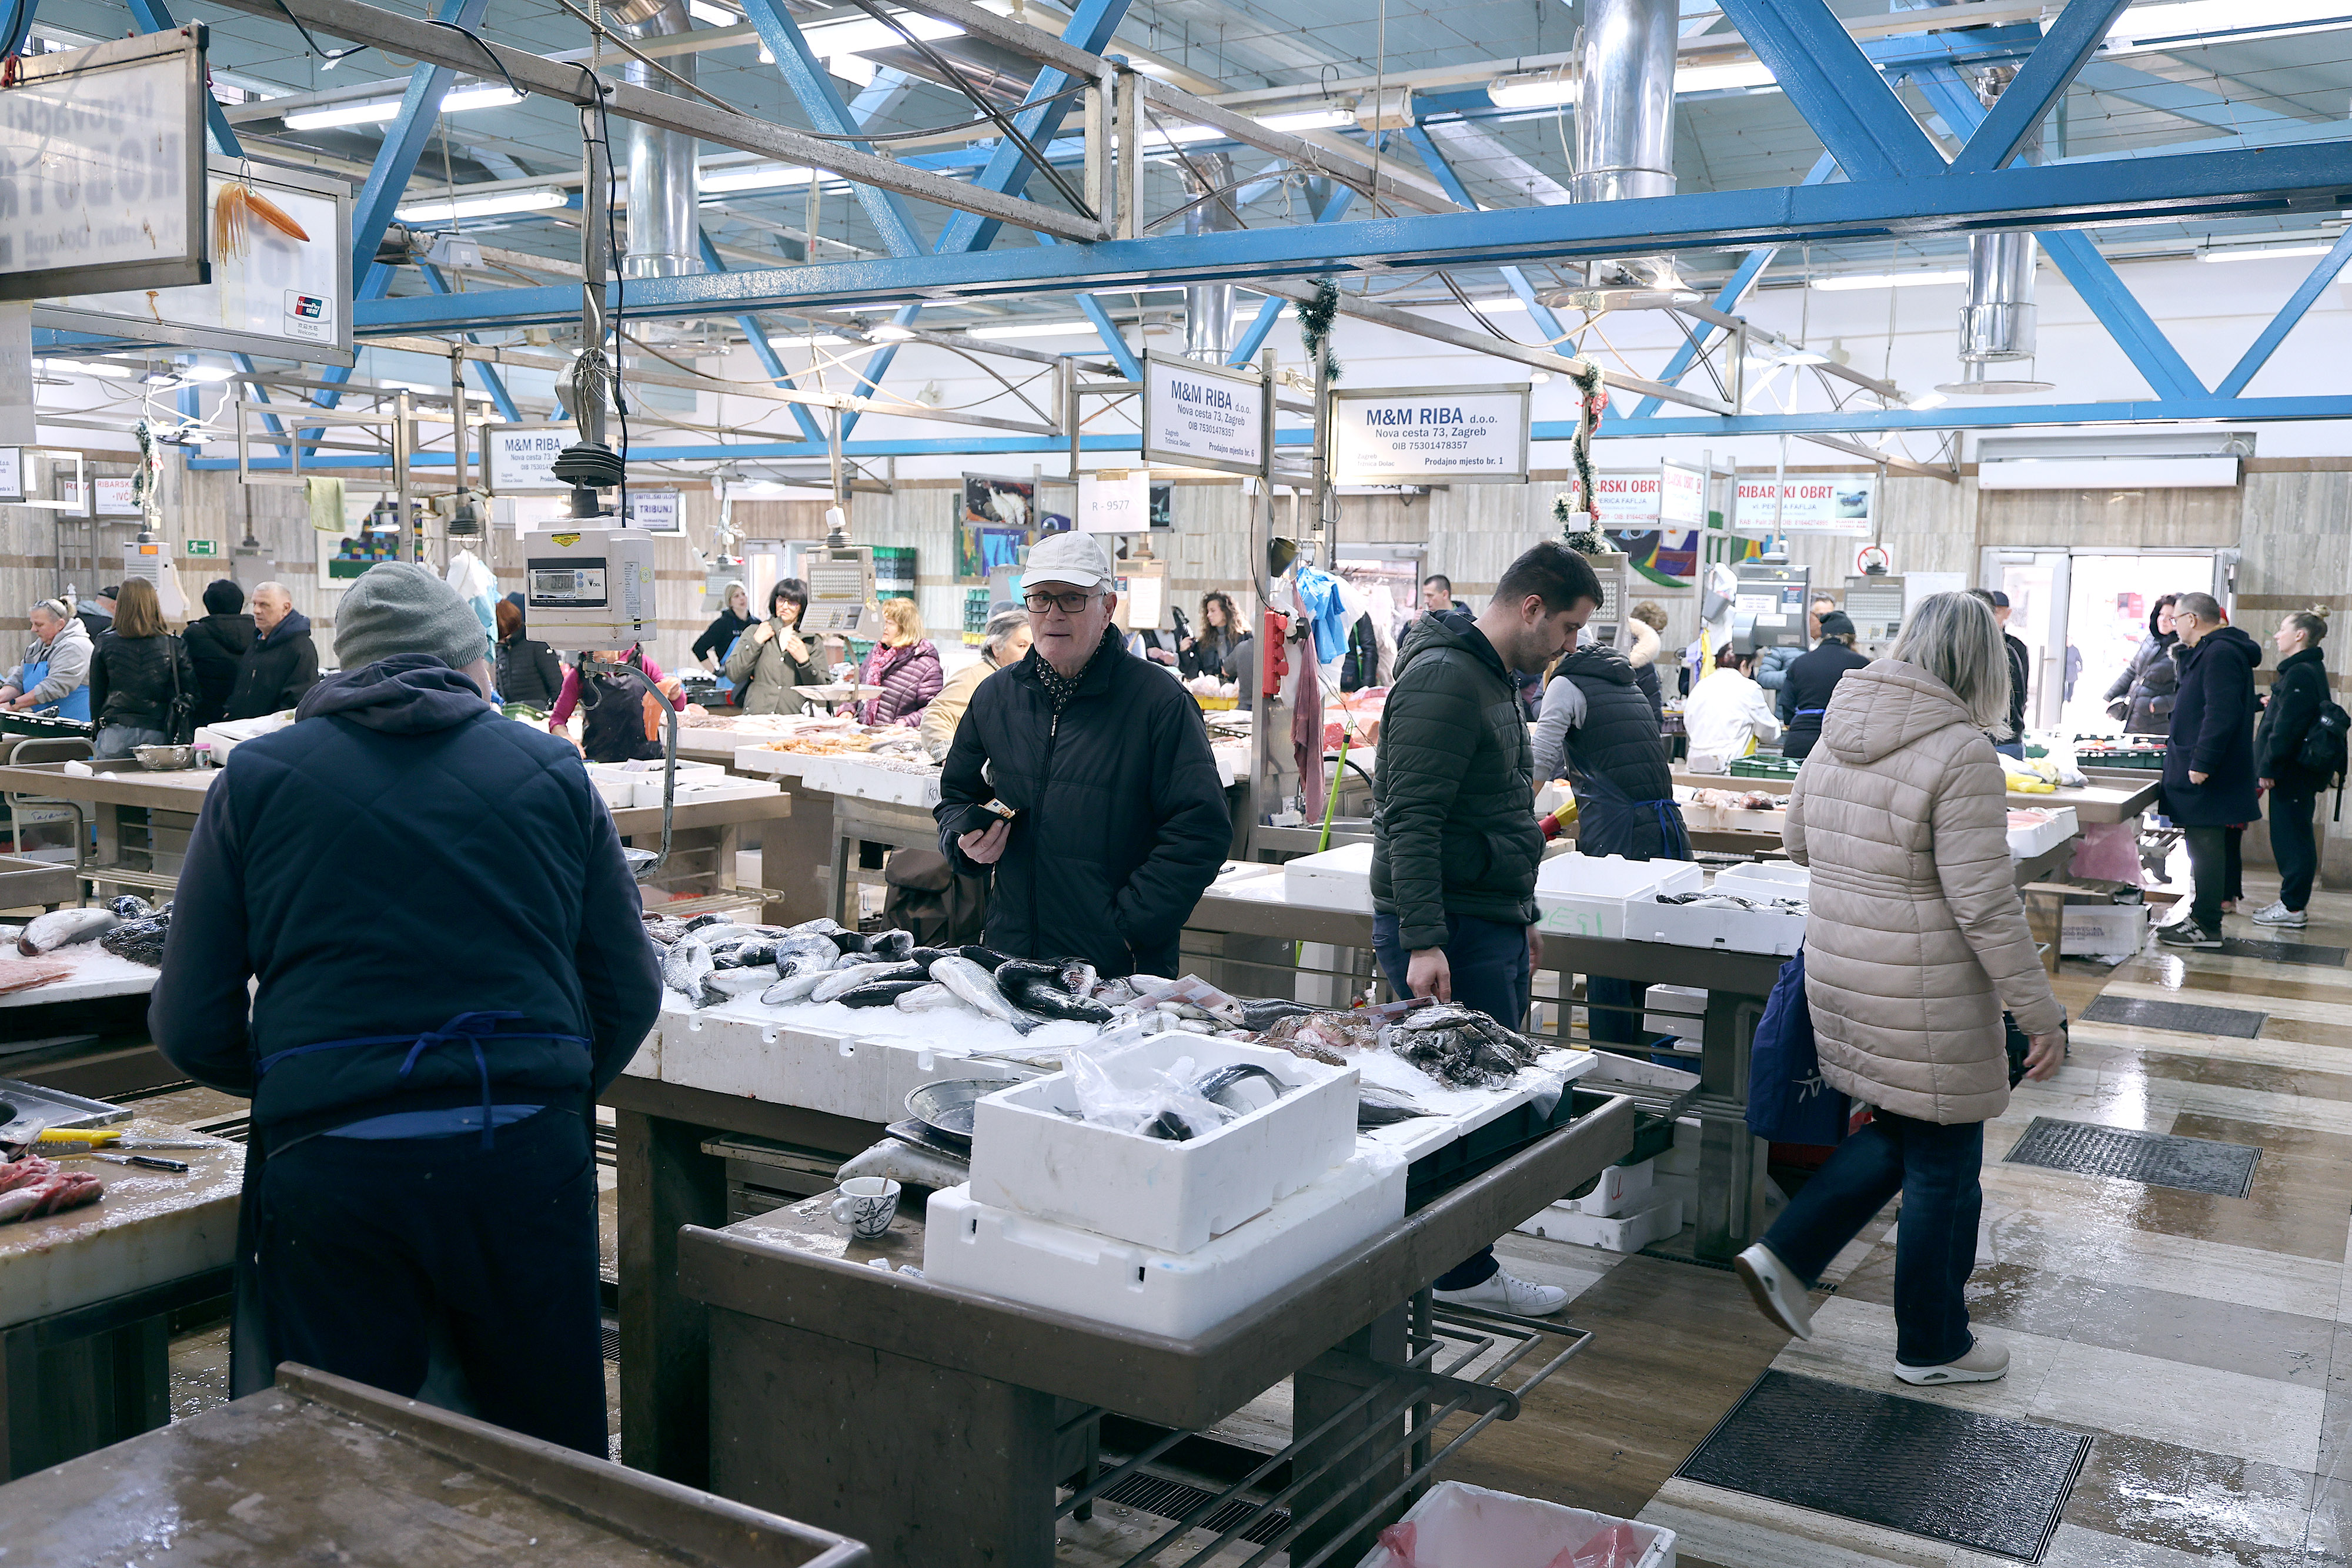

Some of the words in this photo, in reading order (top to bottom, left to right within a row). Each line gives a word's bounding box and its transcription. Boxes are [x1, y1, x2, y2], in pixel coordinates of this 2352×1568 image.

[298, 300, 320, 311] UnionPay
[1171, 380, 1201, 404] M&M
[1206, 387, 1232, 410] RIBA
[1235, 403, 1251, 414] d.o.o.
[1177, 403, 1193, 416] Nova
[1195, 409, 1211, 420] cesta
[1214, 411, 1223, 423] 73,
[1225, 413, 1245, 426] Zagreb
[1367, 408, 1412, 425] M&M
[1420, 407, 1463, 424] RIBA
[1470, 414, 1498, 423] d.o.o.
[1165, 429, 1179, 437] Zagreb
[1188, 421, 1198, 430] OIB
[1199, 423, 1234, 437] 75301478357
[1375, 429, 1399, 437] Nova
[1402, 428, 1429, 437] cesta
[1433, 427, 1448, 438] 73,
[1452, 427, 1486, 438] Zagreb
[505, 439, 531, 451] M&M
[536, 438, 560, 450] RIBA
[1180, 439, 1191, 447] Dolac
[1409, 442, 1468, 450] 75301478357
[1209, 442, 1228, 453] Prodajno
[1230, 446, 1244, 456] mjesto
[1425, 457, 1457, 466] Prodajno
[1459, 457, 1484, 466] mjesto
[1486, 457, 1496, 465] br.
[1739, 486, 1796, 498] RIBARKI
[1800, 486, 1833, 499] OBRT
[639, 505, 672, 513] TRIBUNJ
[1093, 502, 1098, 511] R
[1107, 500, 1130, 510] 9577
